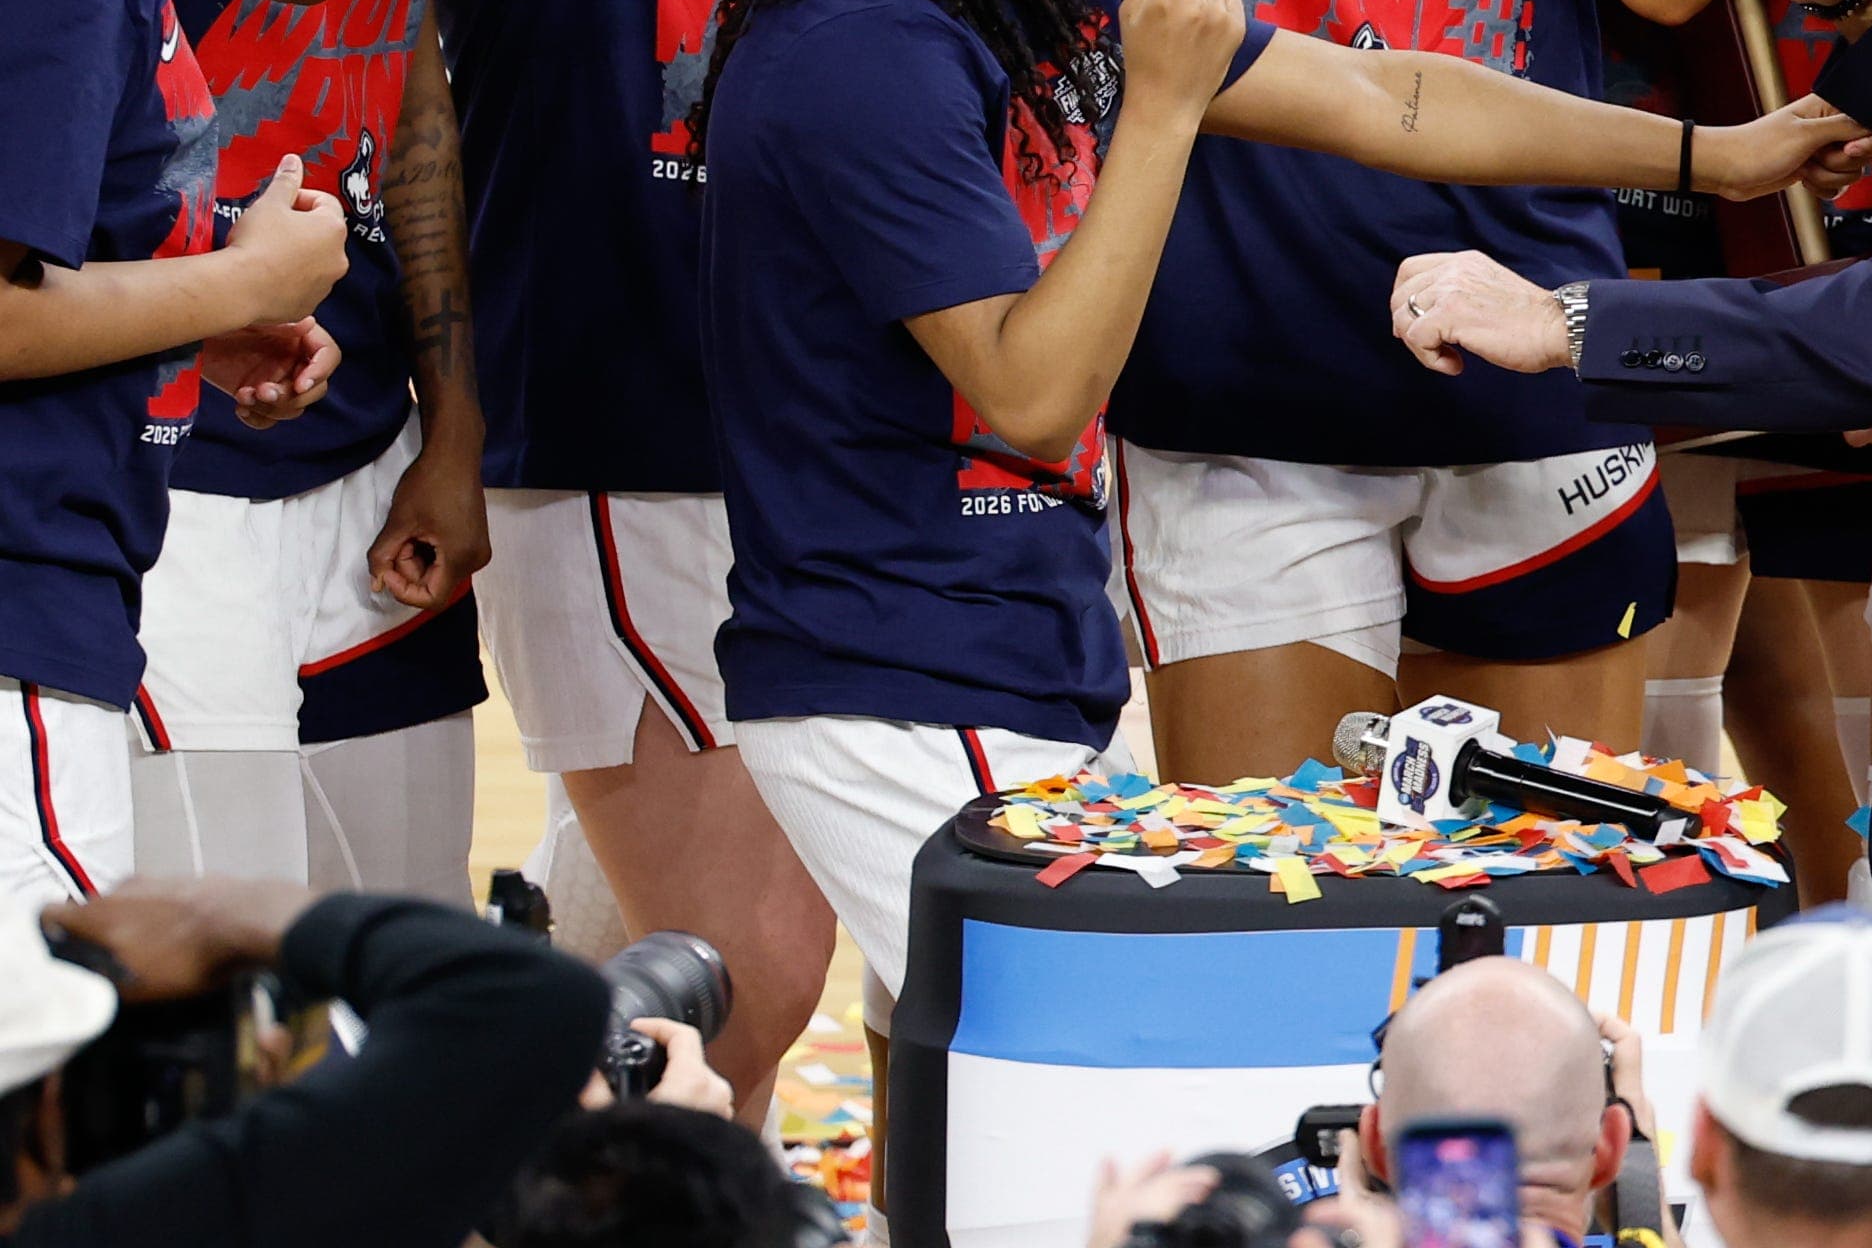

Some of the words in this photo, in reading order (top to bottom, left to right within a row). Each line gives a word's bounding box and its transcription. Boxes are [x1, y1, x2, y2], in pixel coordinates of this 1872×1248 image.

[140, 424, 179, 446] 2026
[1557, 440, 1655, 516] HUSKI
[961, 495, 1012, 516] 2026
[1401, 755, 1416, 795] MARCH
[1412, 741, 1430, 794] MADNESS
